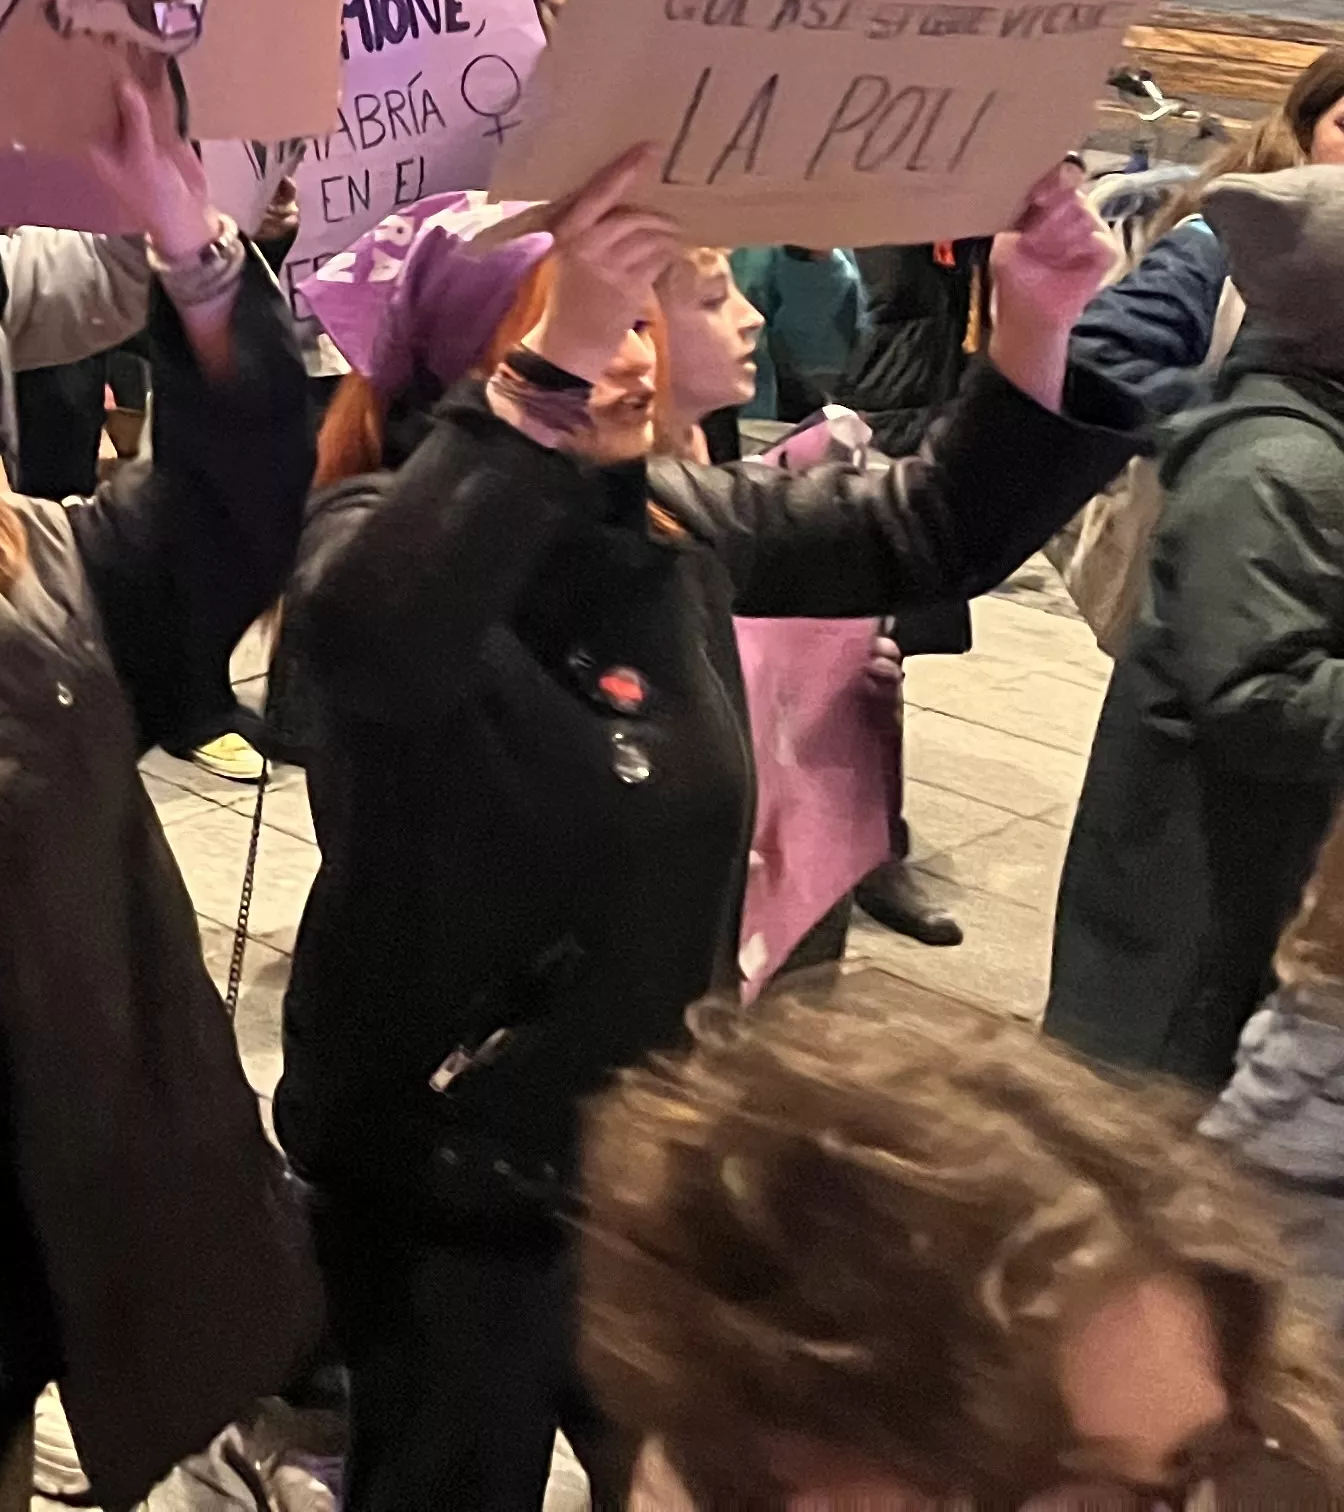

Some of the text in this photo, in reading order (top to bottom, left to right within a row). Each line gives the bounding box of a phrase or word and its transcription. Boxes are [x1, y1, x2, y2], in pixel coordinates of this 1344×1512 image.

[314, 70, 447, 162] ABRÍA
[659, 66, 1000, 186] LA POLI
[321, 167, 371, 223] EN
